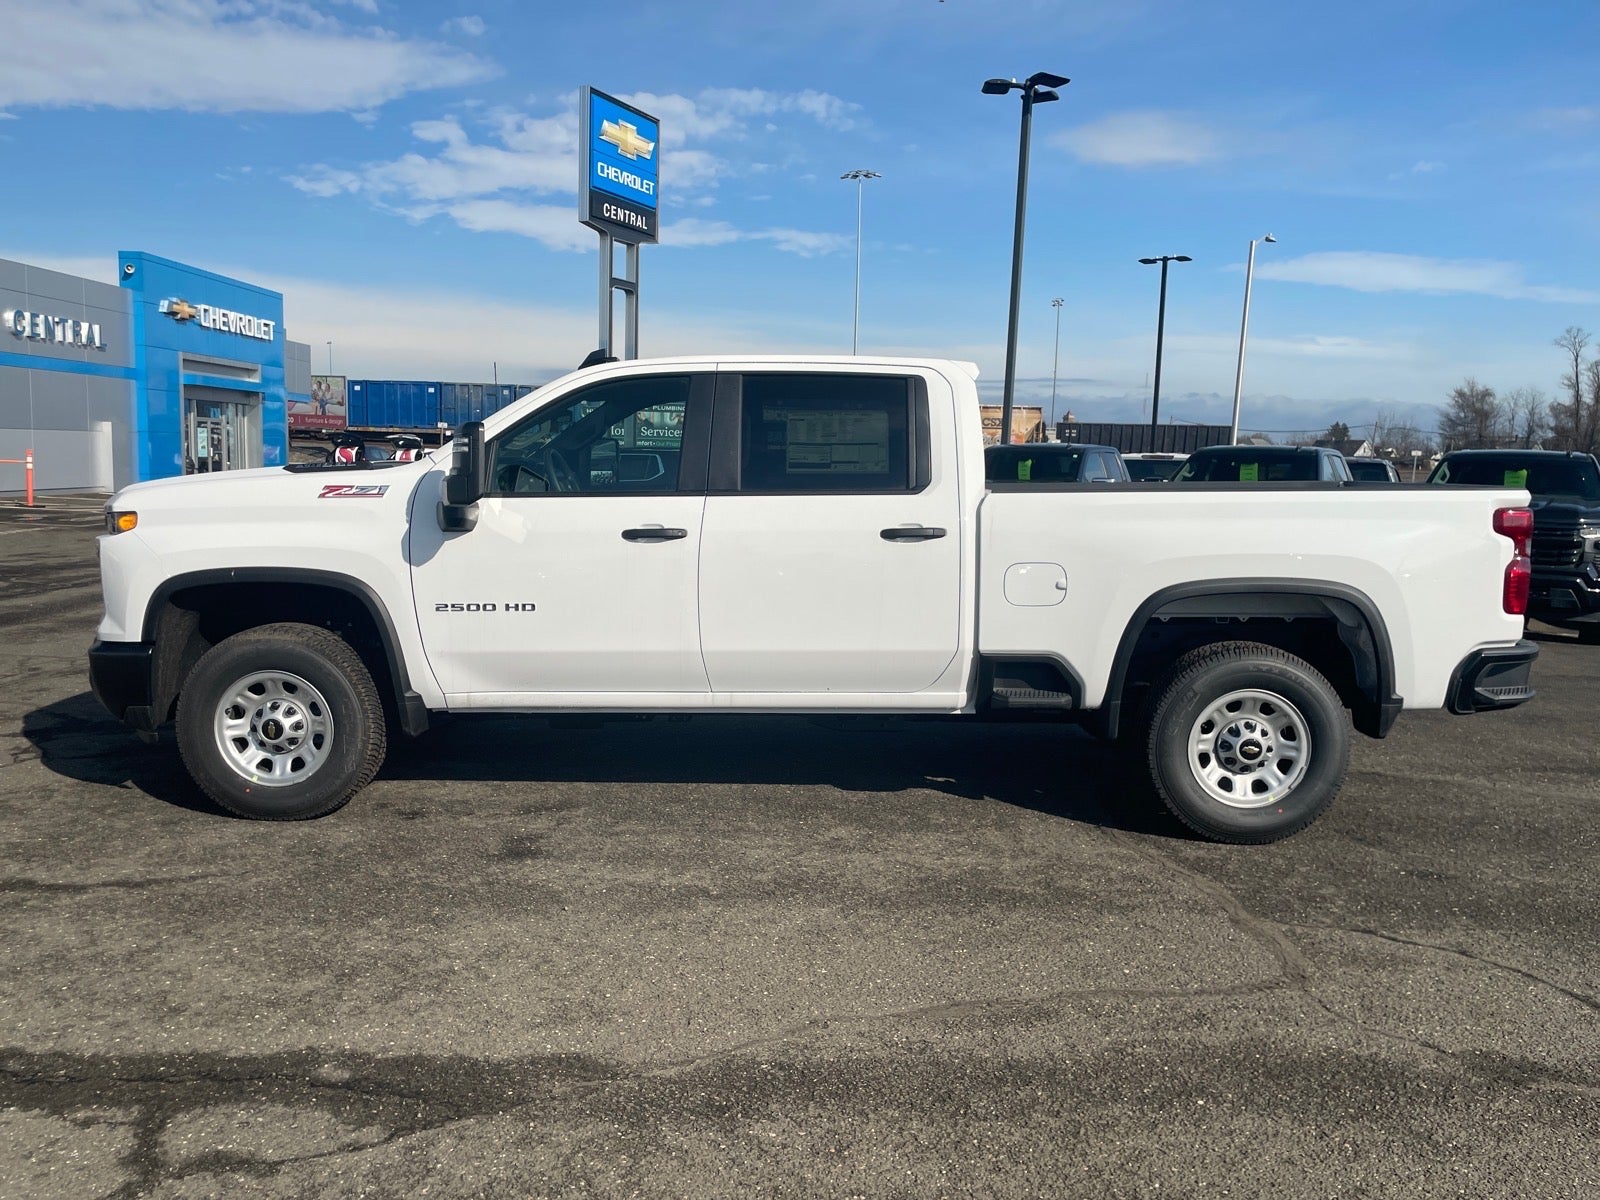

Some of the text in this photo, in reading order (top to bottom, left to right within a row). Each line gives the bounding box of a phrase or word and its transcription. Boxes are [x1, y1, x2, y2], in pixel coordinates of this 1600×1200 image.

[597, 161, 655, 195] CHEVROLET
[603, 203, 648, 230] CENTRAL
[7, 309, 107, 347] CENTRAL
[199, 304, 275, 341] CHEVROLET
[317, 484, 390, 498] Z71
[435, 603, 536, 612] 2500 HD
